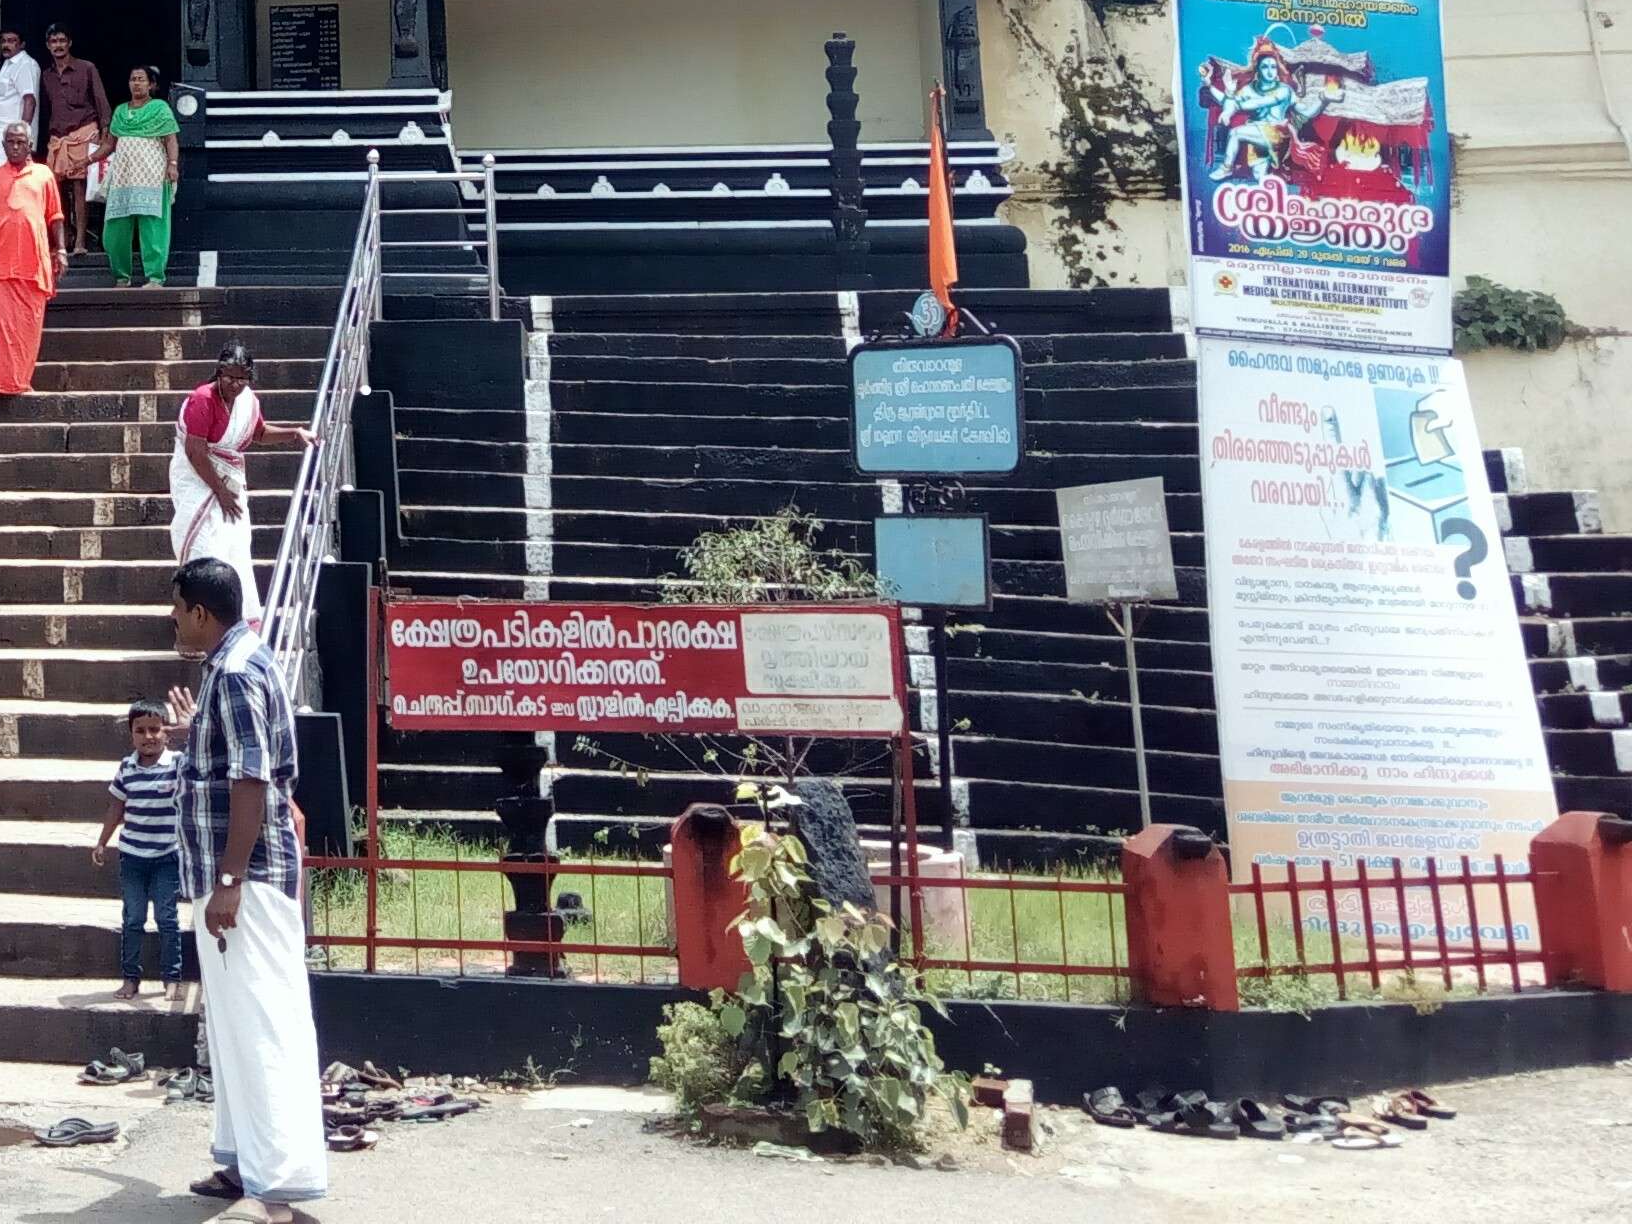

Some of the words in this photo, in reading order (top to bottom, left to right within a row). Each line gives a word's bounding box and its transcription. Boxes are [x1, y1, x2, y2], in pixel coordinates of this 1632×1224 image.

[1241, 212, 1408, 253] യജ്ഞം
[1242, 284, 1279, 300] MEDICAL
[1280, 288, 1313, 303] CENTRE
[1321, 292, 1365, 307] RESEARCH
[1366, 297, 1409, 310] INSTITUTE
[1263, 275, 1331, 292] INTERNATIONAL
[1332, 282, 1389, 297] ALTERNATIVE
[1228, 349, 1293, 373] ഹൈന്ദവ
[1296, 353, 1364, 381] സമൂഹമേ
[1368, 363, 1426, 388] ഉണരുക
[1258, 392, 1318, 434] വീണ്ടും
[1297, 829, 1370, 851] ഉത്രട്ടാതി
[1338, 855, 1354, 867] 51
